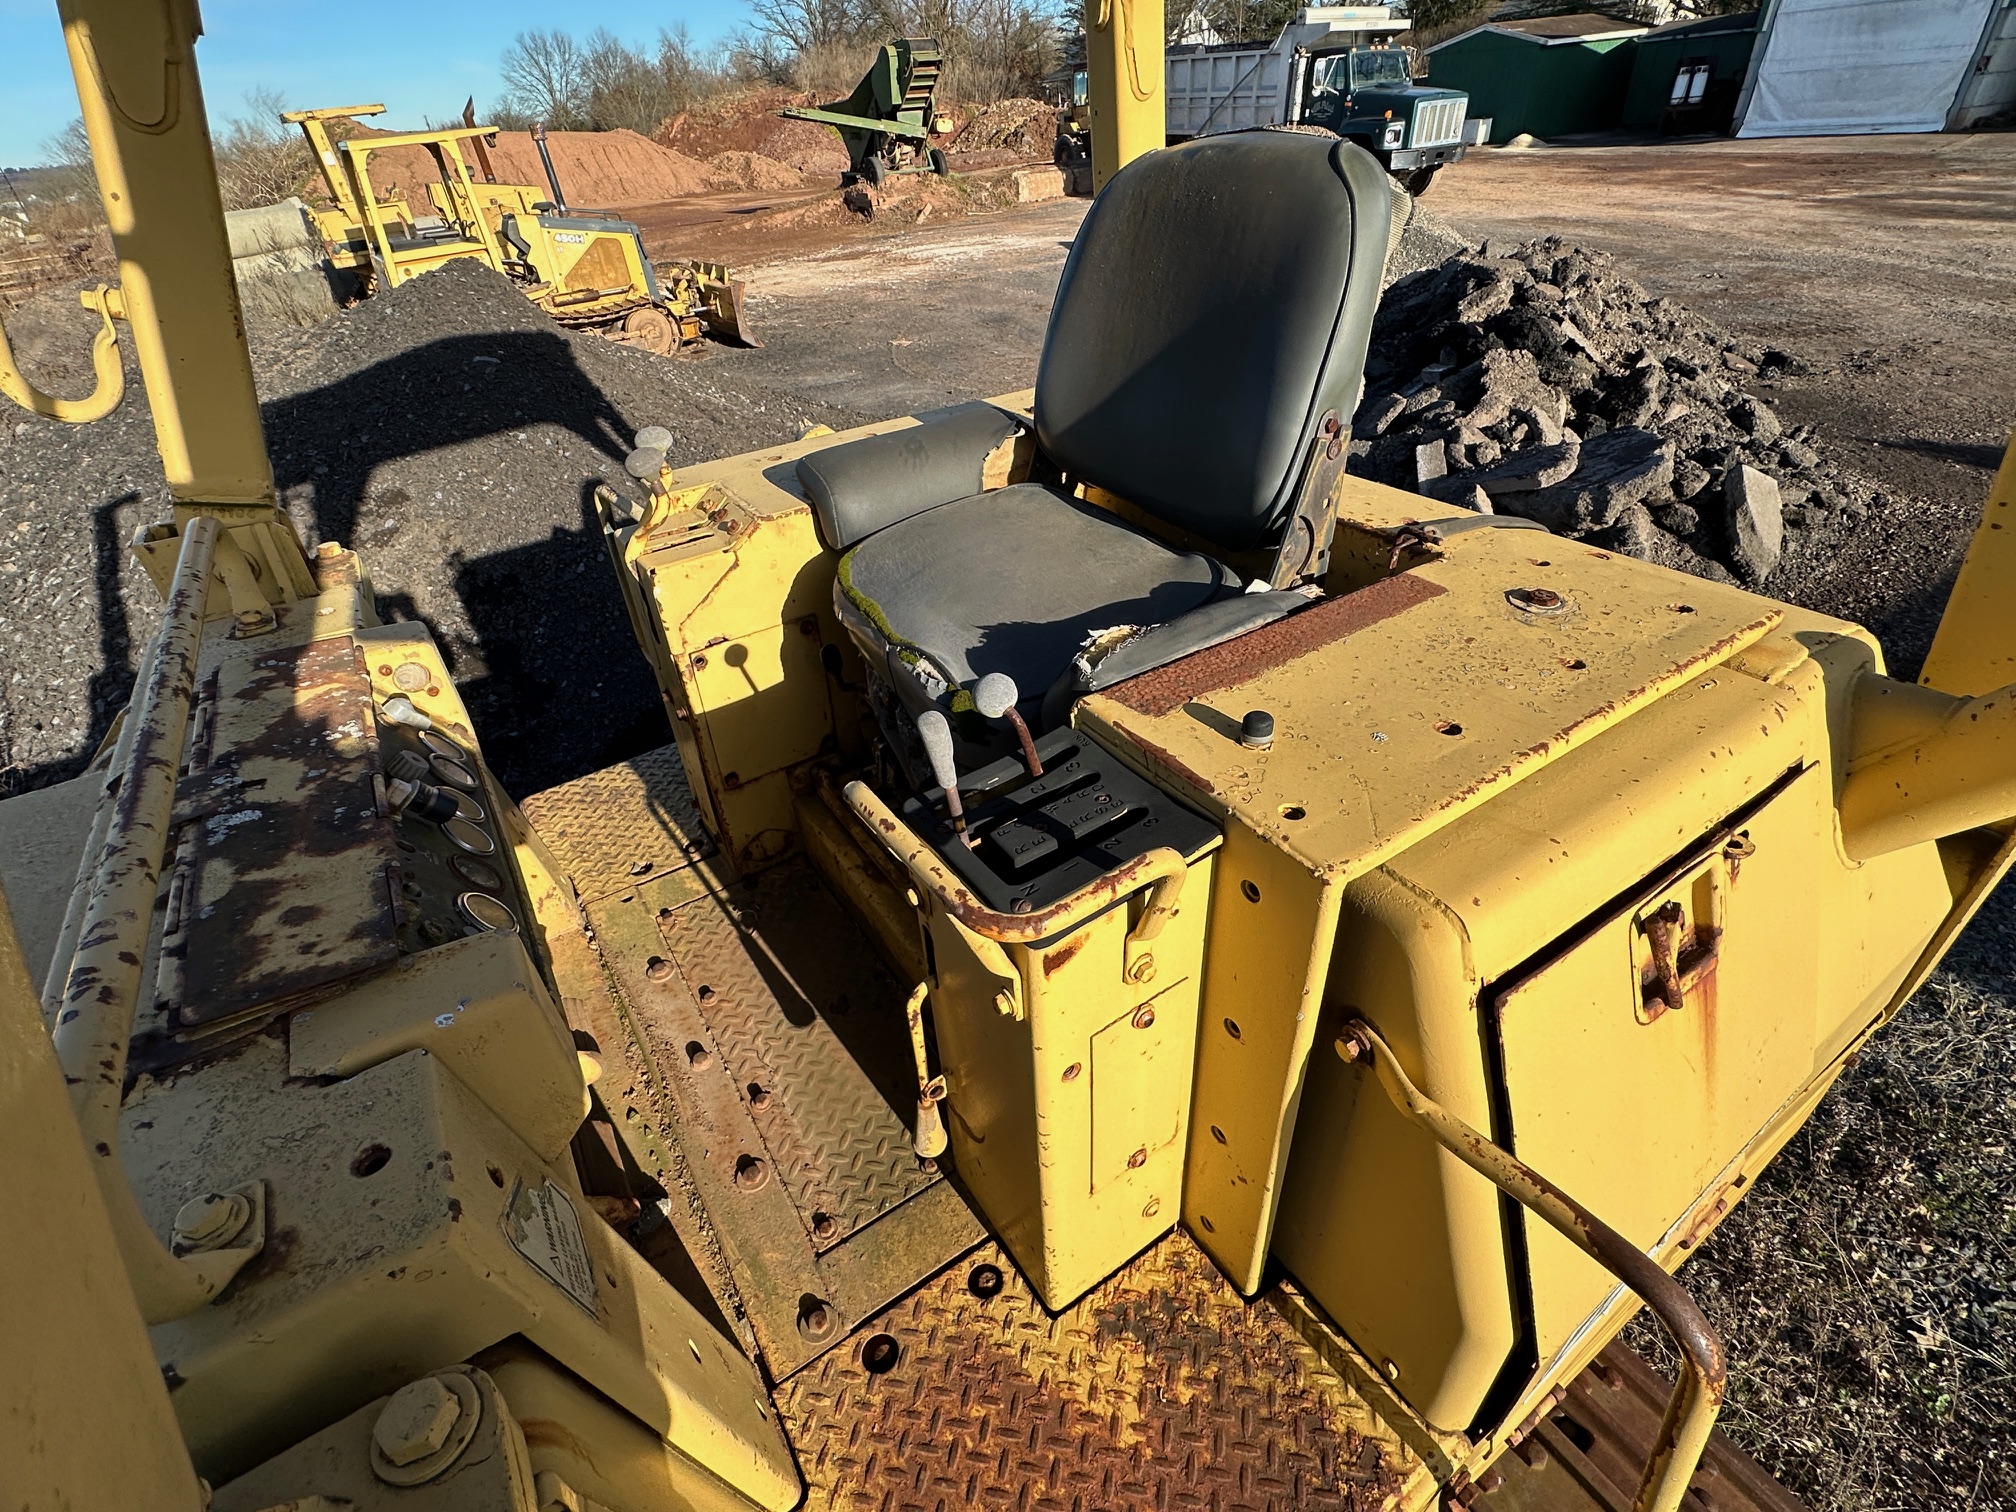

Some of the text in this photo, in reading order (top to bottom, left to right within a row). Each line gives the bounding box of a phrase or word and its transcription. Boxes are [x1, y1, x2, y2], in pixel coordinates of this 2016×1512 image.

[553, 233, 585, 244] 450H
[1030, 783, 1047, 794] 2
[1065, 761, 1081, 773] 3
[997, 784, 1105, 837] FORWARD
[1014, 799, 1124, 855] REVERSE
[1020, 883, 1040, 896] N
[1103, 838, 1121, 850] 2
[1142, 818, 1159, 828] 3
[536, 1191, 558, 1253] WARNING
